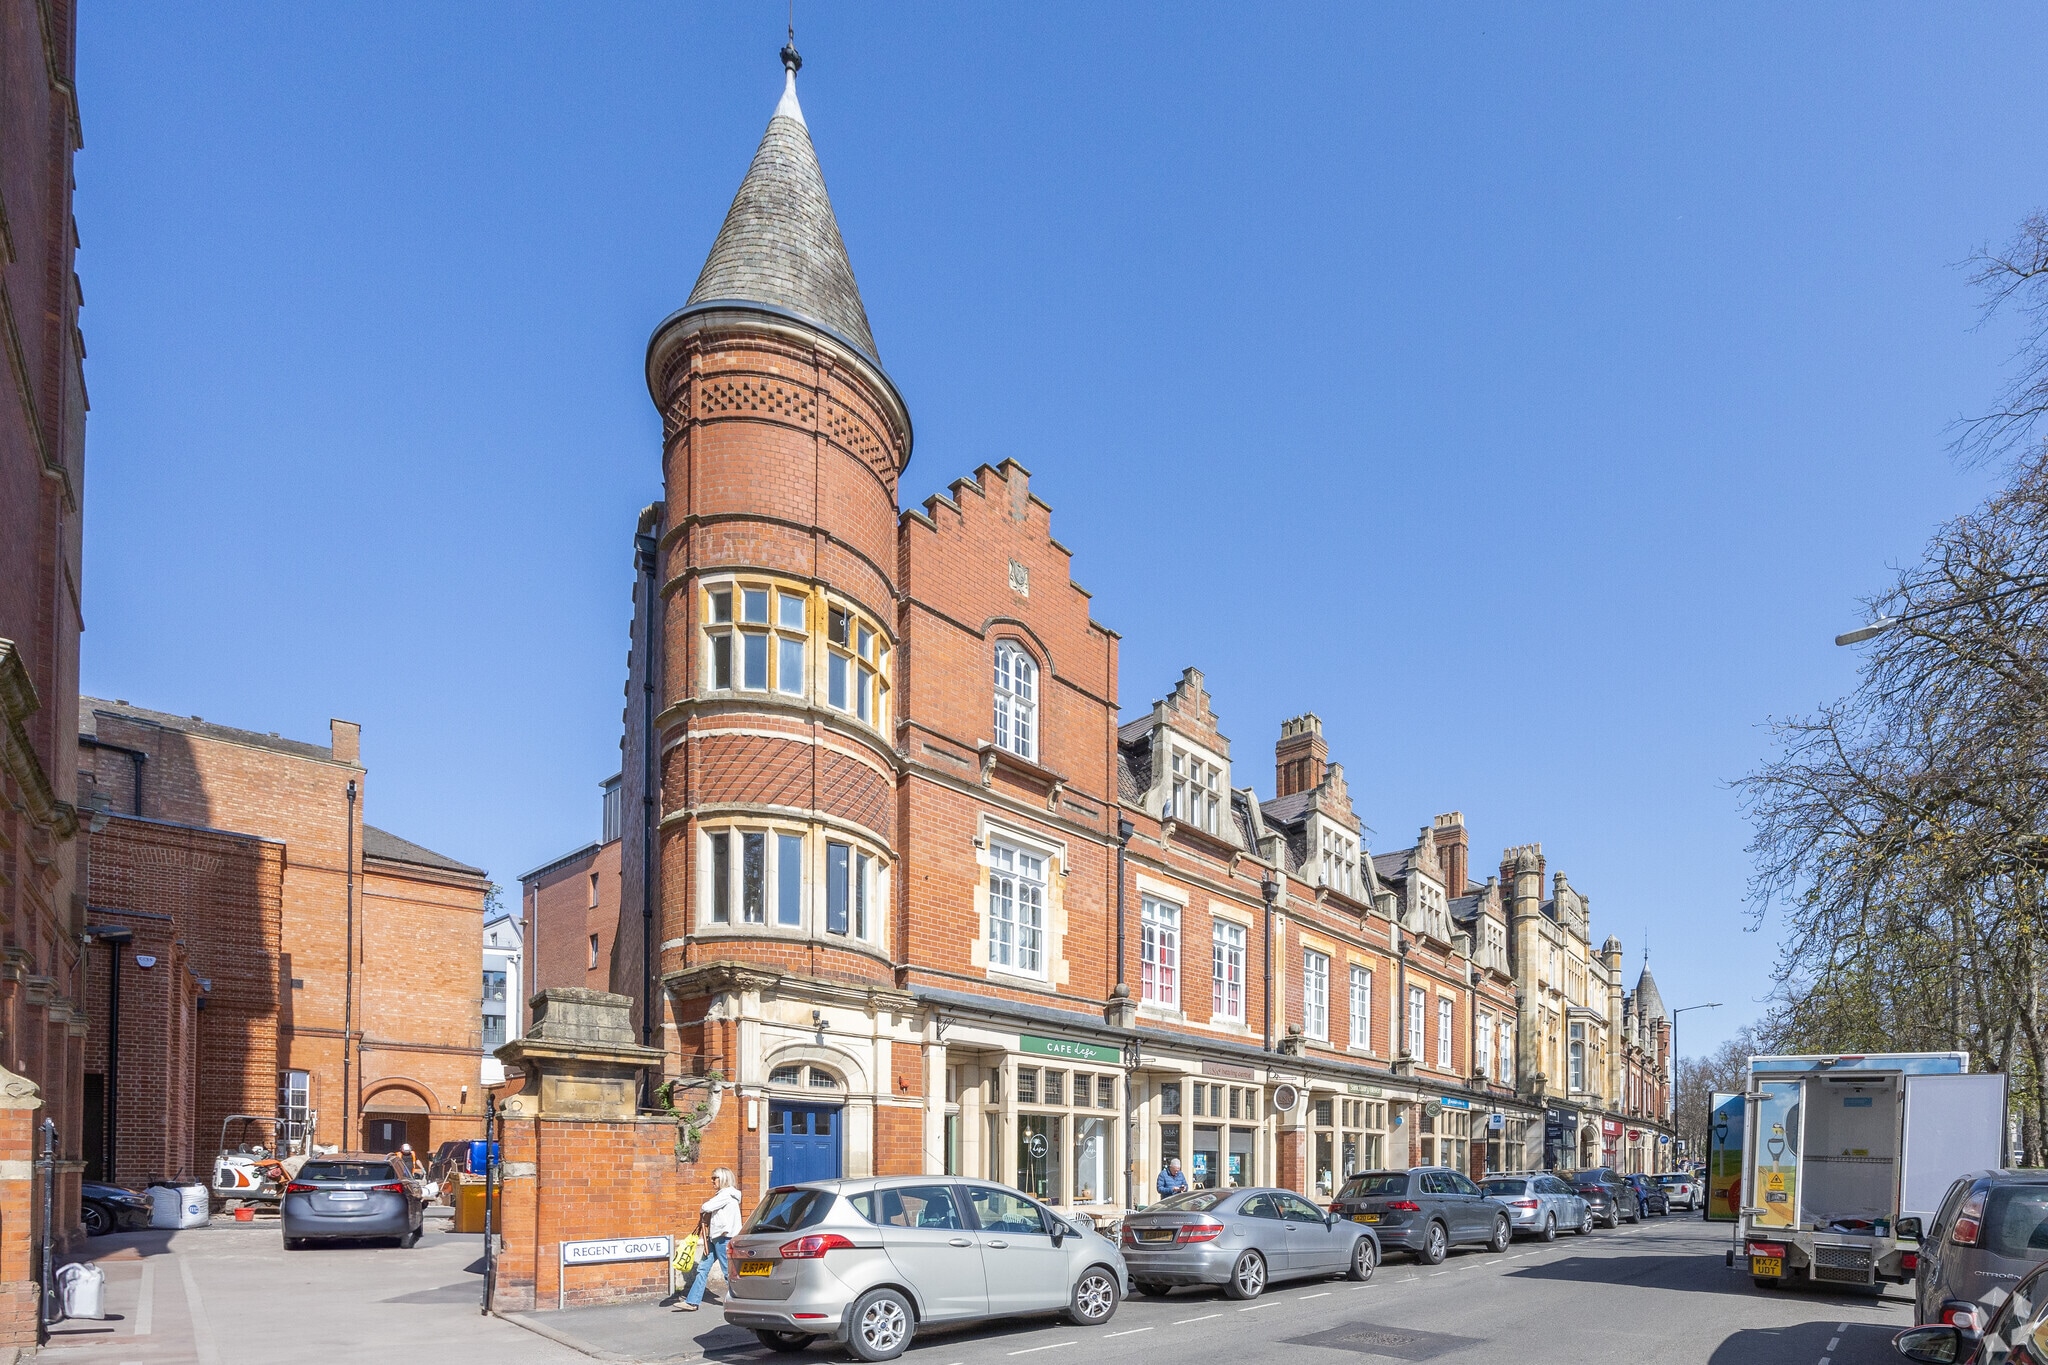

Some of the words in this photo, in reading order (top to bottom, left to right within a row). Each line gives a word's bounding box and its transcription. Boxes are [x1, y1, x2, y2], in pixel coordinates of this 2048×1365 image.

[1047, 1043, 1072, 1054] CAFE
[573, 1245, 618, 1257] REGENT
[624, 1242, 662, 1254] GROVE
[1755, 1257, 1779, 1267] WX72
[1758, 1266, 1776, 1275] UDT
